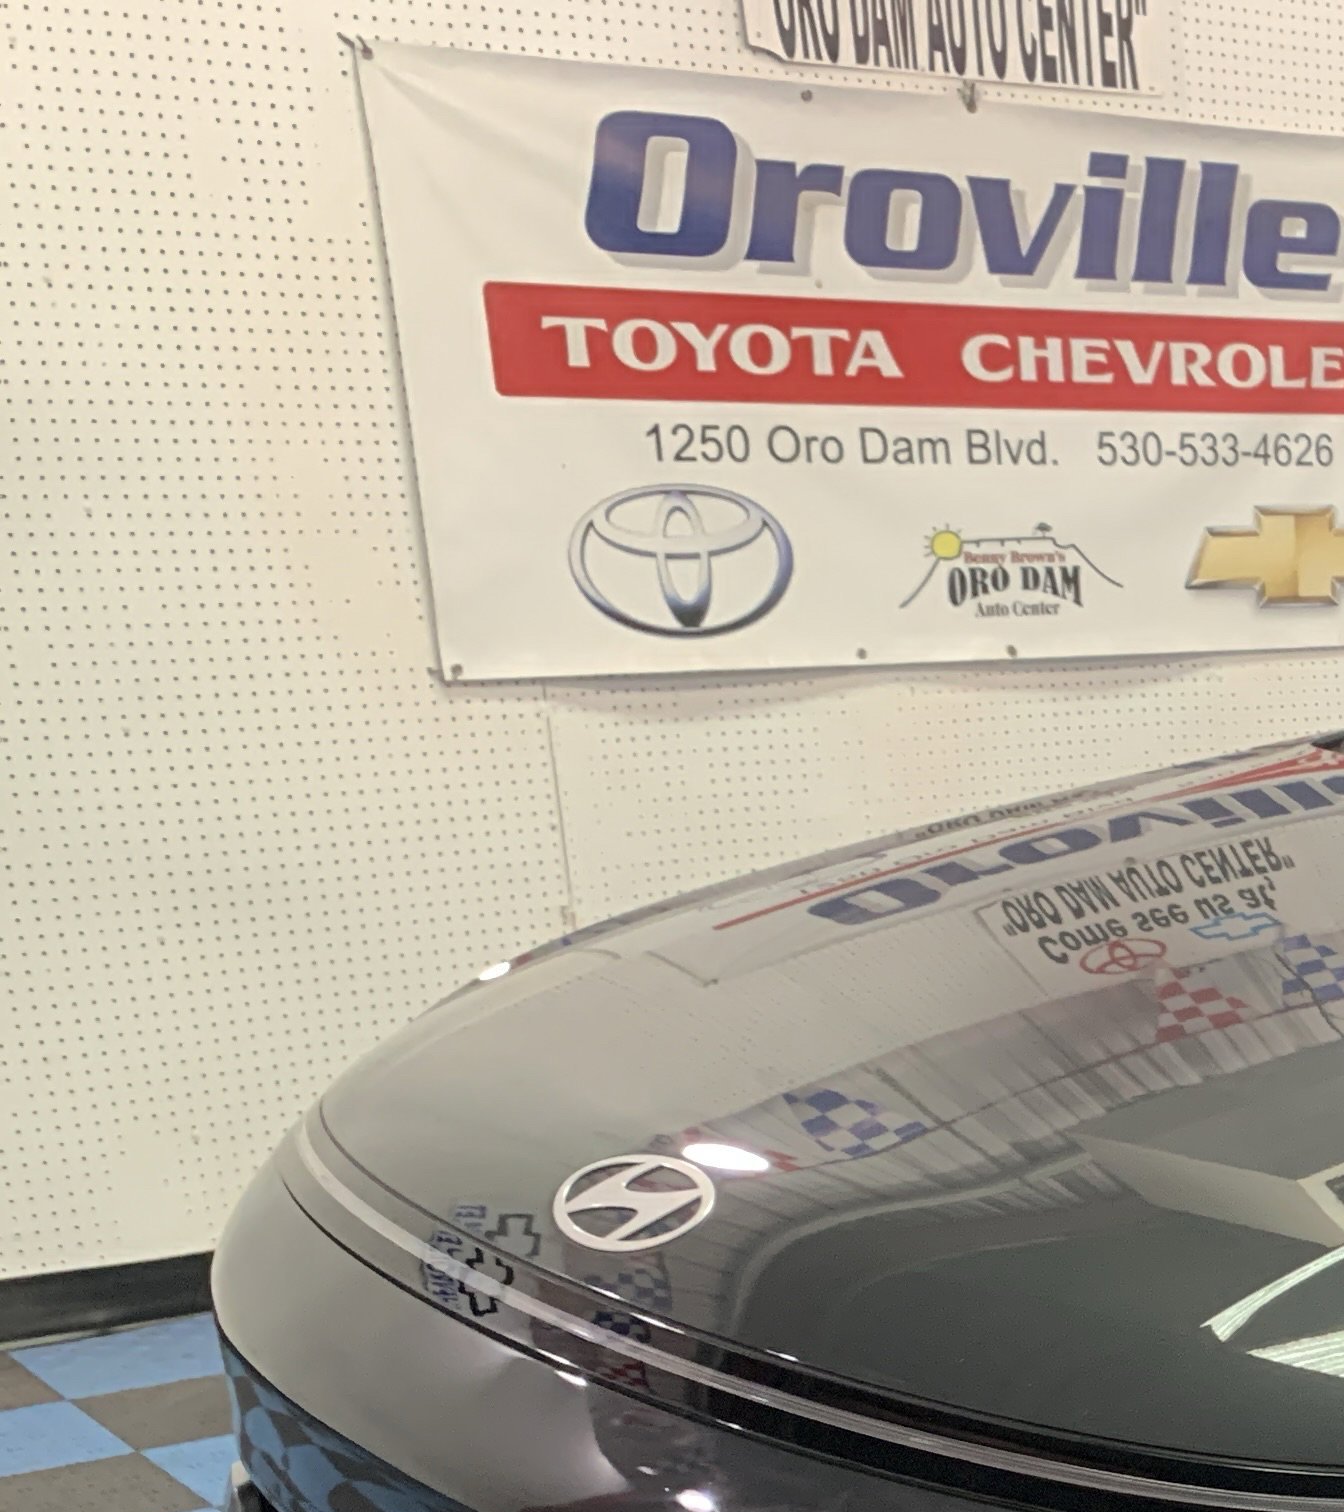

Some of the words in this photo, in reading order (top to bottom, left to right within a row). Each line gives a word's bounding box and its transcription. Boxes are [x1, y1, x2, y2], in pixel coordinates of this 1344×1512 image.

[852, 0, 919, 71] DAM
[928, 0, 1007, 80] AUTO
[584, 109, 1344, 292] Oroville
[541, 315, 904, 378] TOYOTA
[645, 423, 751, 465] 1250
[767, 425, 844, 466] Oro
[861, 427, 951, 467] Dam
[968, 429, 1058, 467] Blvd.
[1096, 431, 1334, 468] 530-533-4626
[964, 551, 1006, 566] Benny
[1010, 550, 1066, 564] Brown's
[948, 566, 1010, 608] ORO
[1020, 565, 1083, 608] DAM
[975, 602, 1010, 618] Auto
[1012, 601, 1060, 617] Center
